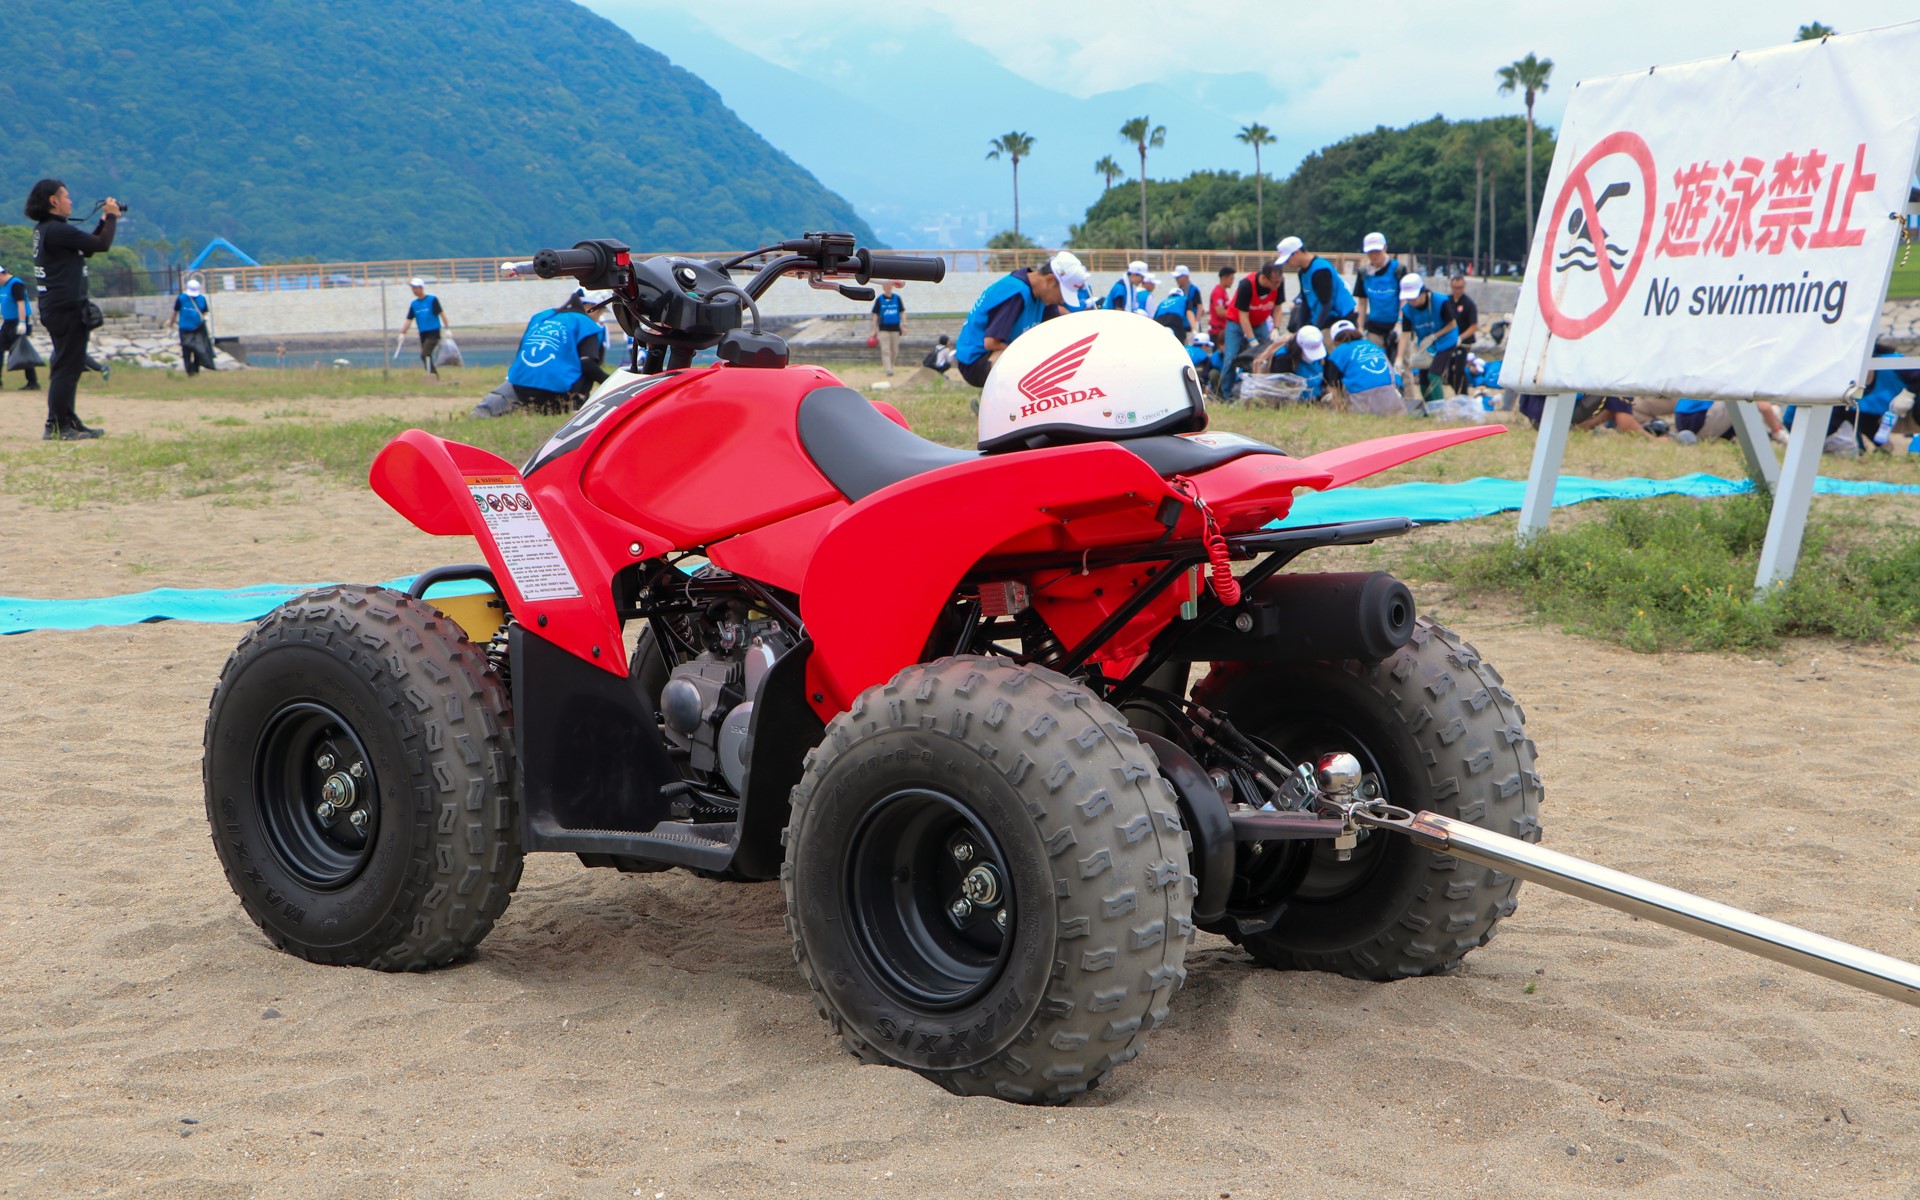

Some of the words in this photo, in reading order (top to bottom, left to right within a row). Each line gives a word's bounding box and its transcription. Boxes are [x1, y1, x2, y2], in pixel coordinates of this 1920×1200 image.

[1654, 143, 1877, 260] 遊泳禁止
[1644, 276, 1680, 317] No
[1688, 271, 1848, 324] swimming
[1020, 387, 1108, 418] HONDA
[873, 986, 1024, 1055] MAXXIS
